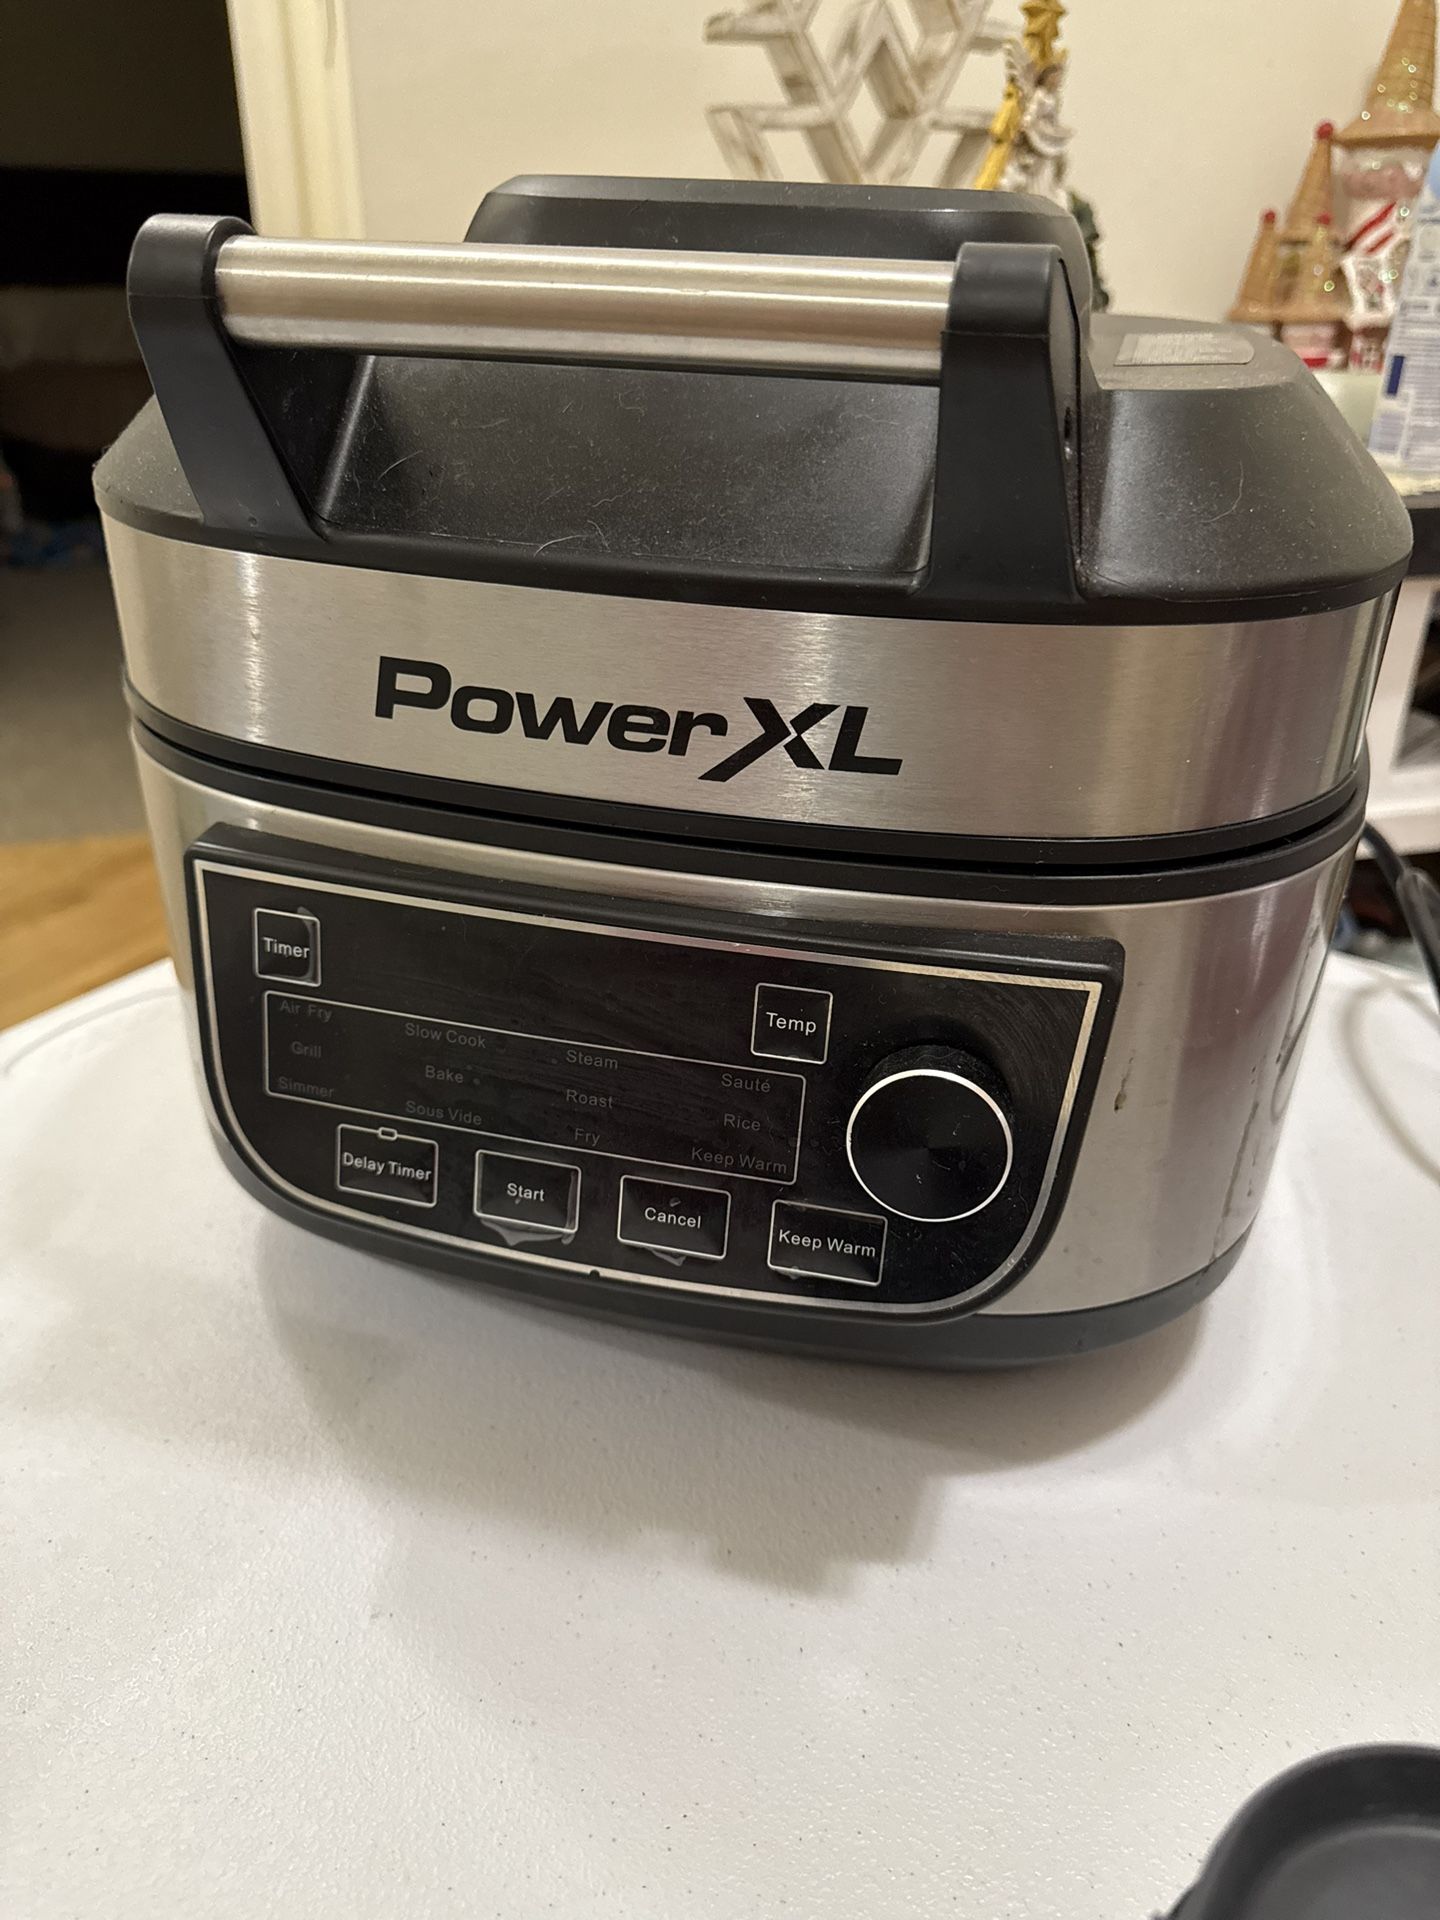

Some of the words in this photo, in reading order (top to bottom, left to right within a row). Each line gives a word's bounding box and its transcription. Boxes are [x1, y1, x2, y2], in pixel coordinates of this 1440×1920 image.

[375, 656, 903, 782] PowerXL
[263, 937, 310, 959] Timer
[280, 1000, 300, 1014] Air
[307, 1004, 333, 1022] Fry
[766, 1012, 817, 1035] Temp
[405, 1023, 441, 1041] Slow
[446, 1029, 486, 1048] Cook
[291, 1042, 322, 1058] Grill
[566, 1049, 619, 1070] Steam
[425, 1066, 464, 1083] Bake
[721, 1073, 771, 1093] Sauté
[279, 1077, 335, 1098] Simmer
[566, 1089, 614, 1108] Roast
[405, 1101, 443, 1119] Sous
[448, 1107, 483, 1125] Vide
[724, 1114, 761, 1131] Rice
[574, 1129, 600, 1146] Fry
[343, 1153, 384, 1175] Delay
[388, 1160, 432, 1181] Timer
[691, 1147, 734, 1167] Keep
[740, 1155, 787, 1174] Warm
[507, 1183, 545, 1202] Start
[644, 1207, 701, 1229] Cancel
[779, 1228, 822, 1250] Keep
[827, 1237, 876, 1257] Warm
